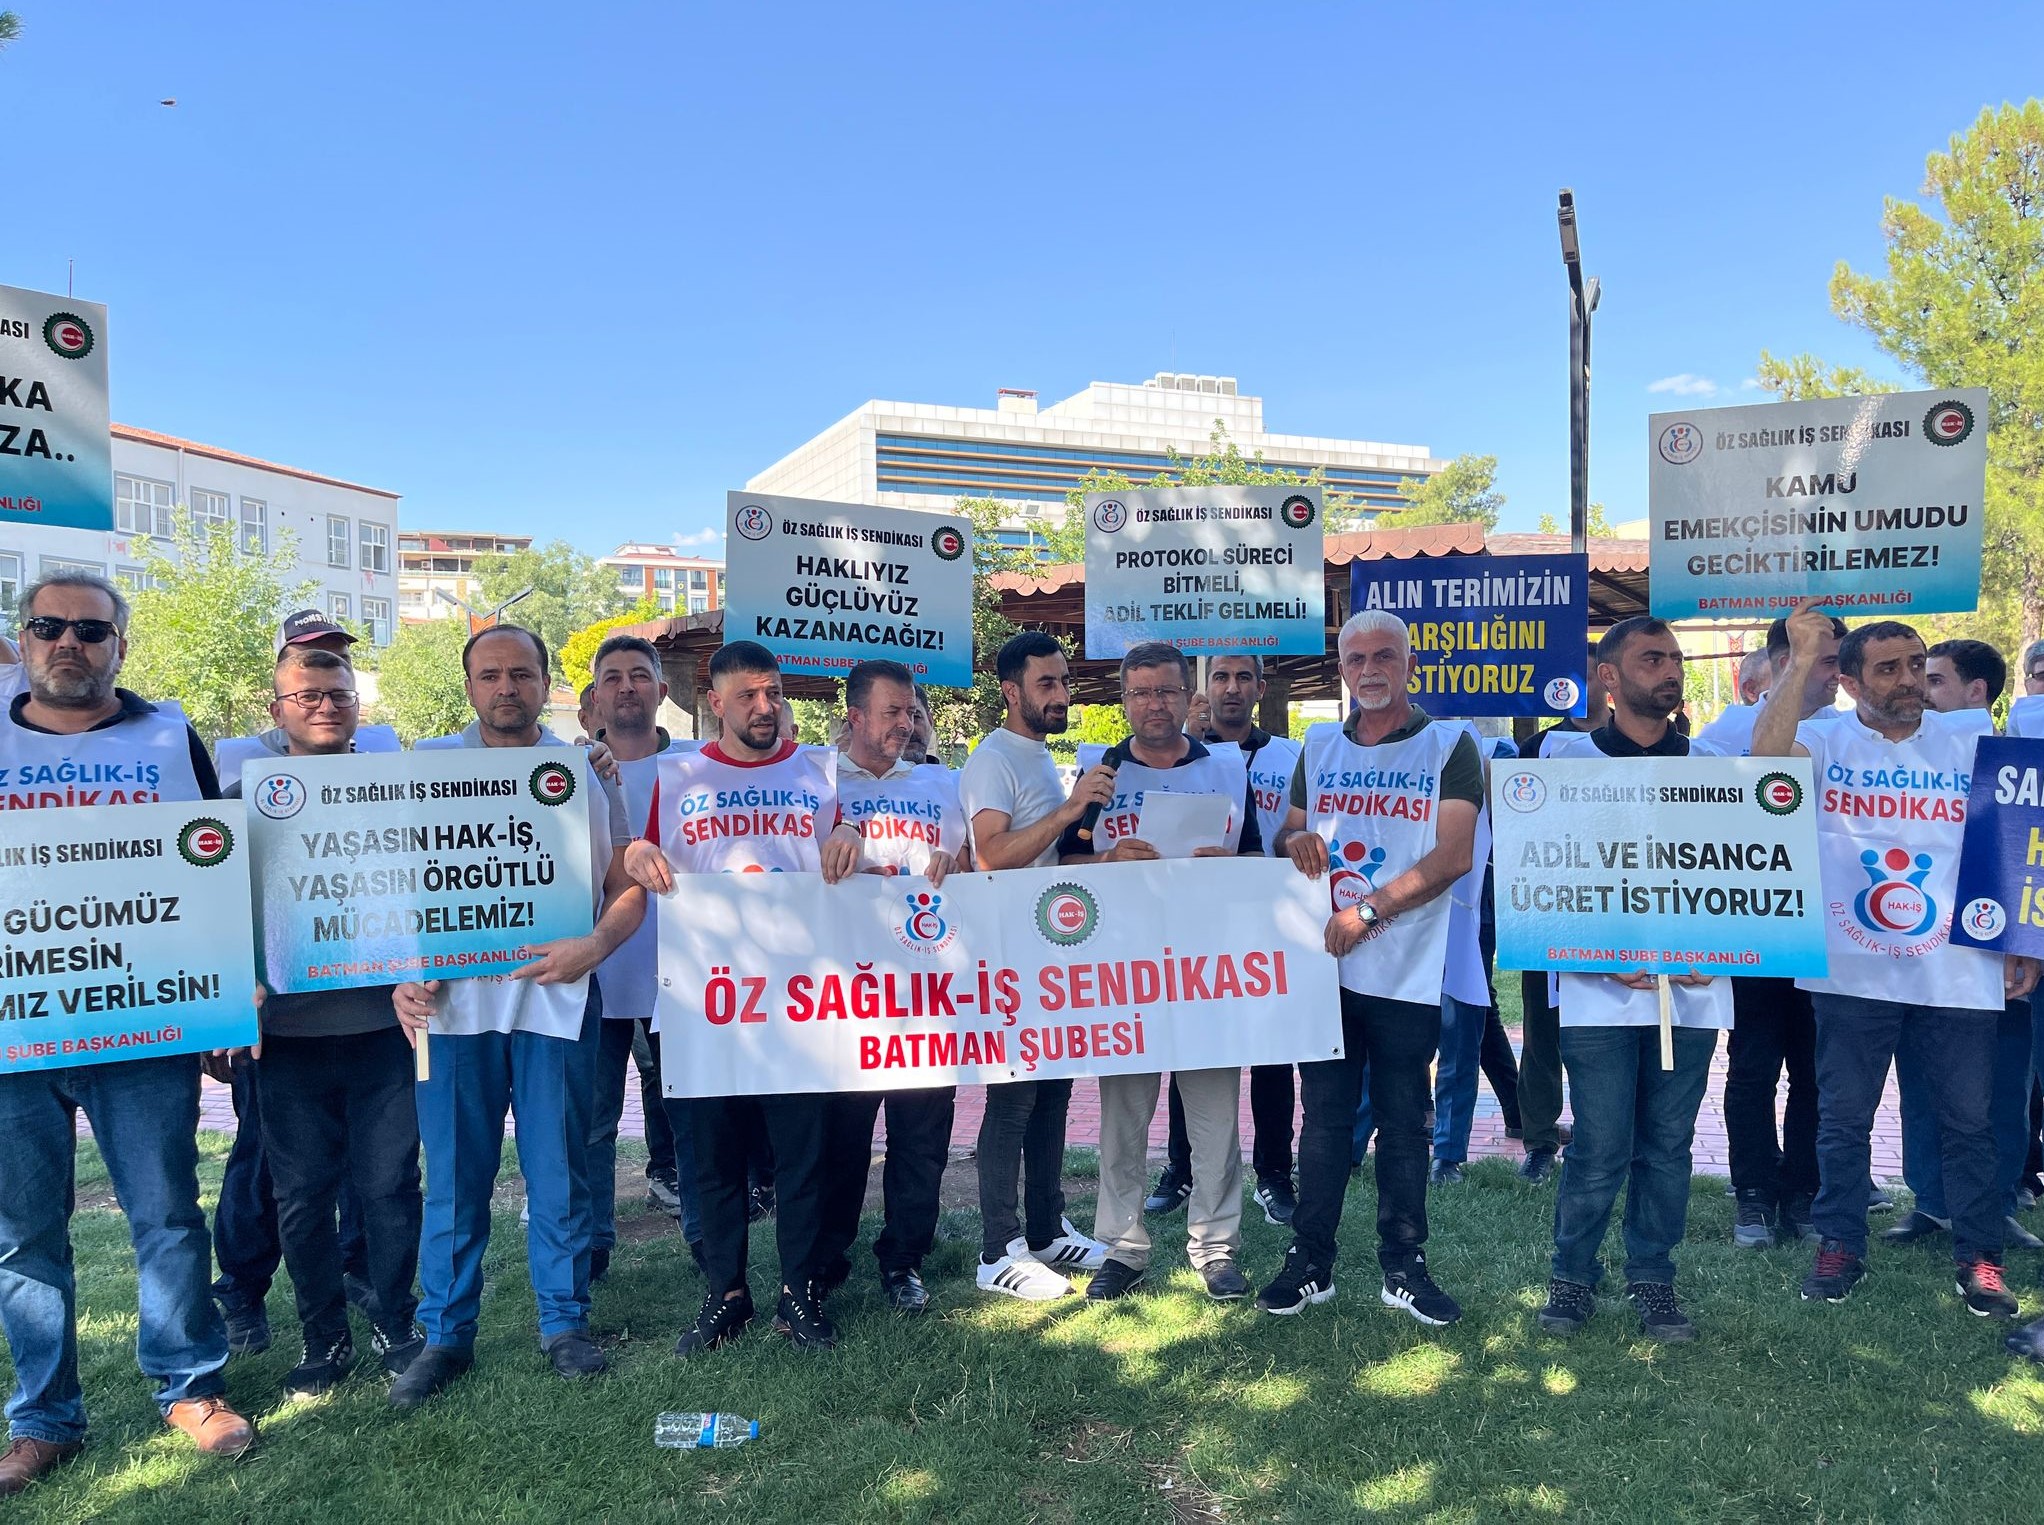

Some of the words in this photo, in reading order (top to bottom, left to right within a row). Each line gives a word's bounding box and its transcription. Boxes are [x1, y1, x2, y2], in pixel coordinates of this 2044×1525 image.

[1716, 432, 1735, 450] ÖZ
[1738, 428, 1795, 448] SAĞLIK
[1799, 425, 1815, 446] İŞ
[1765, 472, 1857, 499] KAMU
[1136, 508, 1150, 522] ÖZ
[1152, 506, 1193, 522] SAĞLIK
[1196, 506, 1207, 522] İŞ
[1210, 505, 1272, 520] SENDİKASI
[1664, 505, 1846, 543] EMEKÇİSİNİN
[1854, 505, 1968, 532] UMUDU
[782, 519, 798, 535] ÖZ
[800, 522, 844, 540] SAĞLIK
[846, 525, 858, 543] İŞ
[861, 529, 923, 548] SENDİKASI
[797, 555, 909, 585] HAKLIYIZ
[1116, 549, 1219, 568] PROTOKOL
[1223, 543, 1293, 565] SÜRECİ
[1687, 543, 1939, 576] GECİKTİRİLEMEZ!
[786, 582, 918, 617] GÜÇLÜYÜZ
[1163, 570, 1245, 596] BİTMELİ,
[1366, 580, 1423, 610] ALIN
[1432, 569, 1571, 608] TERİMİZİN
[1699, 597, 1764, 609] BATMAN
[1816, 590, 1911, 609] AŞKANLIĞI
[1104, 601, 1146, 623] ADİL
[1150, 598, 1215, 621] TEKLİF
[1218, 598, 1306, 620] GELMELİ!
[756, 616, 944, 650] KAZANACAĞIZ!
[1408, 614, 1545, 658] ARŞILIĞINI
[775, 654, 821, 667] ATMAN
[1407, 658, 1535, 694] STİYORUZ
[18, 757, 160, 790] SAĞLIK-İŞ
[1339, 766, 1434, 797] SAĞLIK-İŞ
[1827, 759, 1854, 788] ÖZ
[1862, 765, 1970, 798] SAĞLIK-İŞ
[321, 786, 341, 805] ÖZ
[346, 782, 405, 803] SAĞLIK
[409, 781, 427, 803] İŞ
[430, 777, 517, 799] SENDİKASI
[681, 793, 709, 816] ÖZ
[716, 785, 820, 815] SAĞLIK-İŞ
[1314, 790, 1431, 822] ENDİKASI
[1559, 784, 1578, 803] ÖZ
[1581, 783, 1637, 803] SAĞLIK
[1640, 784, 1656, 805] İŞ
[1659, 784, 1743, 803] SENDİKASI
[1823, 789, 1967, 824] SENDİKAS
[851, 794, 941, 825] SAĞLIK-İŞ
[301, 826, 428, 864] YAŞASIN
[435, 815, 541, 853] HAK-İŞ,
[682, 809, 816, 846] SENDİKAS
[32, 843, 51, 868] İŞ
[56, 838, 163, 864] SENDİKASI
[1520, 834, 1590, 869] ADİL
[1597, 842, 1638, 869] VE
[1646, 834, 1792, 871] İNSANCA
[288, 868, 417, 906] YAŞASIN
[423, 854, 554, 892] ÖRGÜTLÜ
[4, 891, 180, 935] GÜCÜMÜZ
[1510, 877, 1614, 912] ÜCRET
[1621, 878, 1804, 918] İSTİYORUZ!
[1888, 901, 1922, 912] HAK-İŞ
[314, 895, 534, 943] MÜCADELEMİZ!
[308, 962, 383, 978] BATMAN
[434, 946, 532, 968] BAŞKANLIĞI
[1548, 948, 1615, 960] BATMAN
[1619, 949, 1659, 965] ŞUBE
[1663, 950, 1760, 966] BAŞKANLIĞI
[58, 970, 220, 1015] VERİLSİN!
[705, 966, 767, 1025] ÖZ
[786, 960, 1021, 1026] SAĞLIK-İŞ
[1038, 946, 1288, 1012] SENDİKASI
[7, 1039, 57, 1063] ŞUBE
[63, 1025, 182, 1055] BAŞKANLIĞI
[860, 1030, 1006, 1070] BATMAN
[1019, 1013, 1145, 1071] ŞUBESİ
